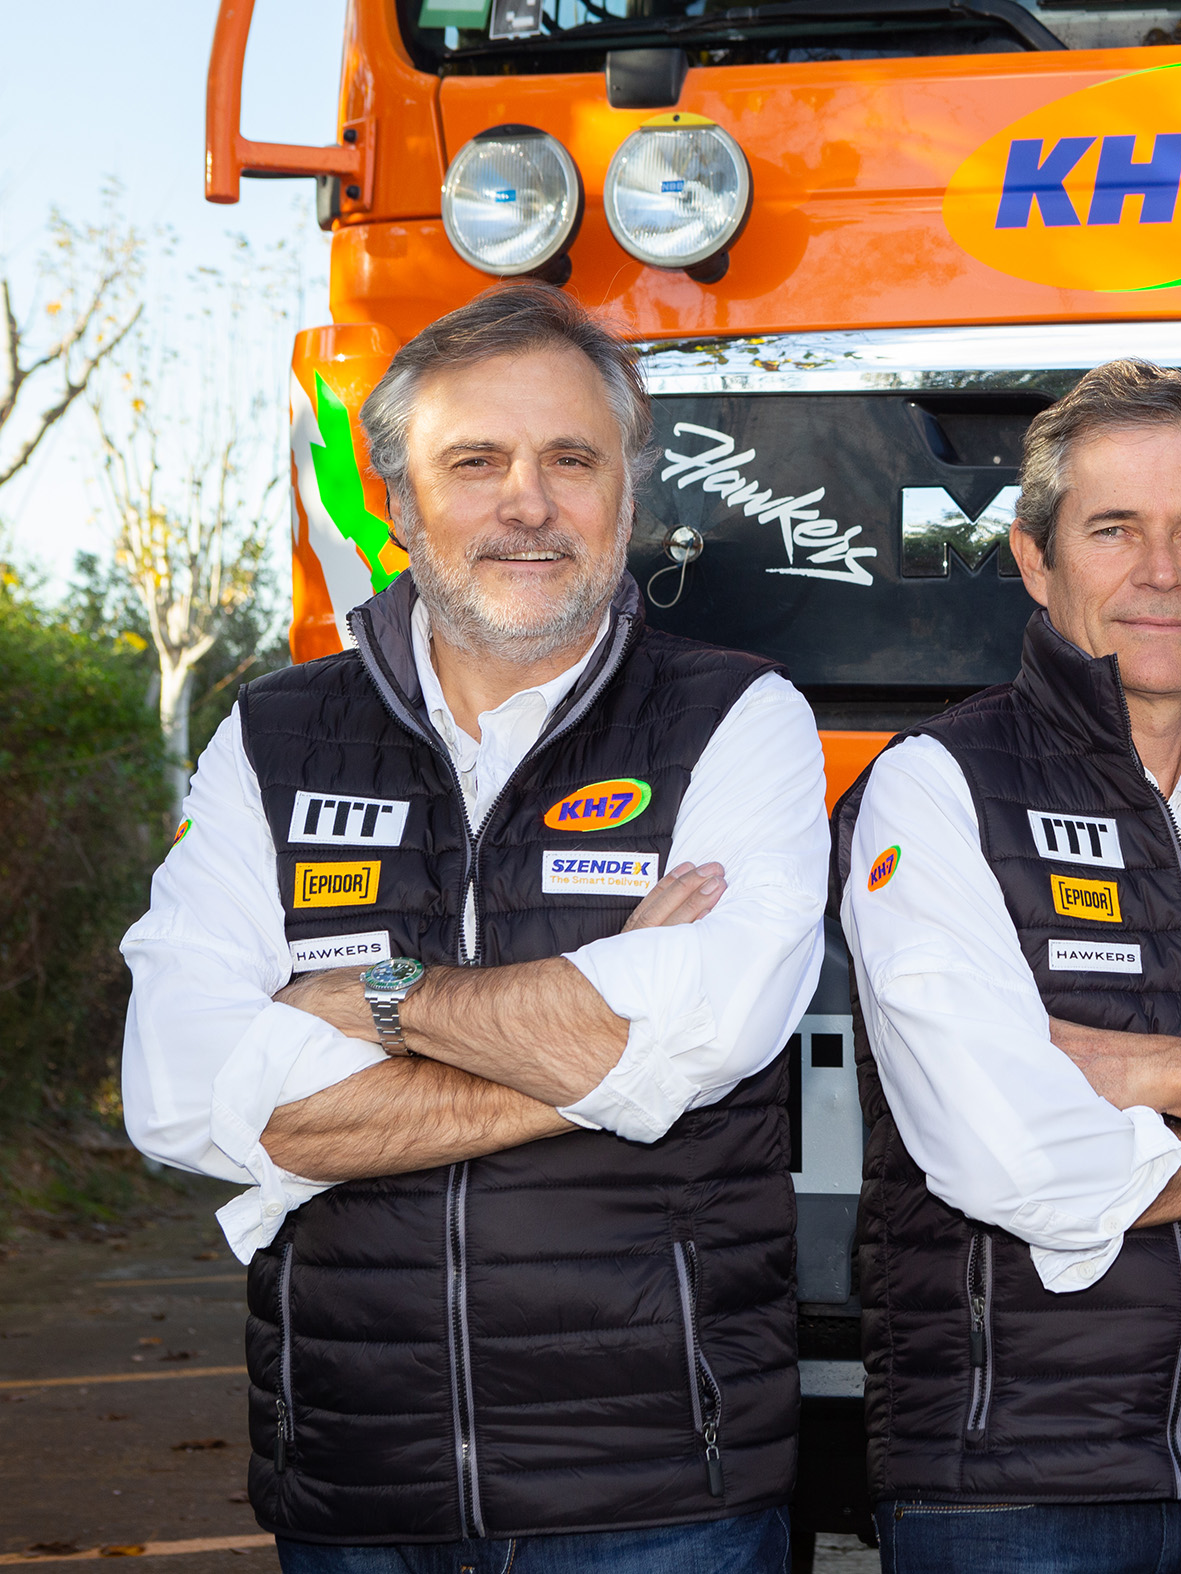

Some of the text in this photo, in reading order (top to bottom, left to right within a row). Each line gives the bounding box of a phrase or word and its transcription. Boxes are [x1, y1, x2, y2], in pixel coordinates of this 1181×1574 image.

[661, 422, 877, 586] Hawkers
[551, 859, 651, 876] SZENDEX
[551, 875, 650, 889] The Smart Delivery
[295, 941, 382, 962] HAWKERS
[1055, 949, 1136, 964] HAWKERS
